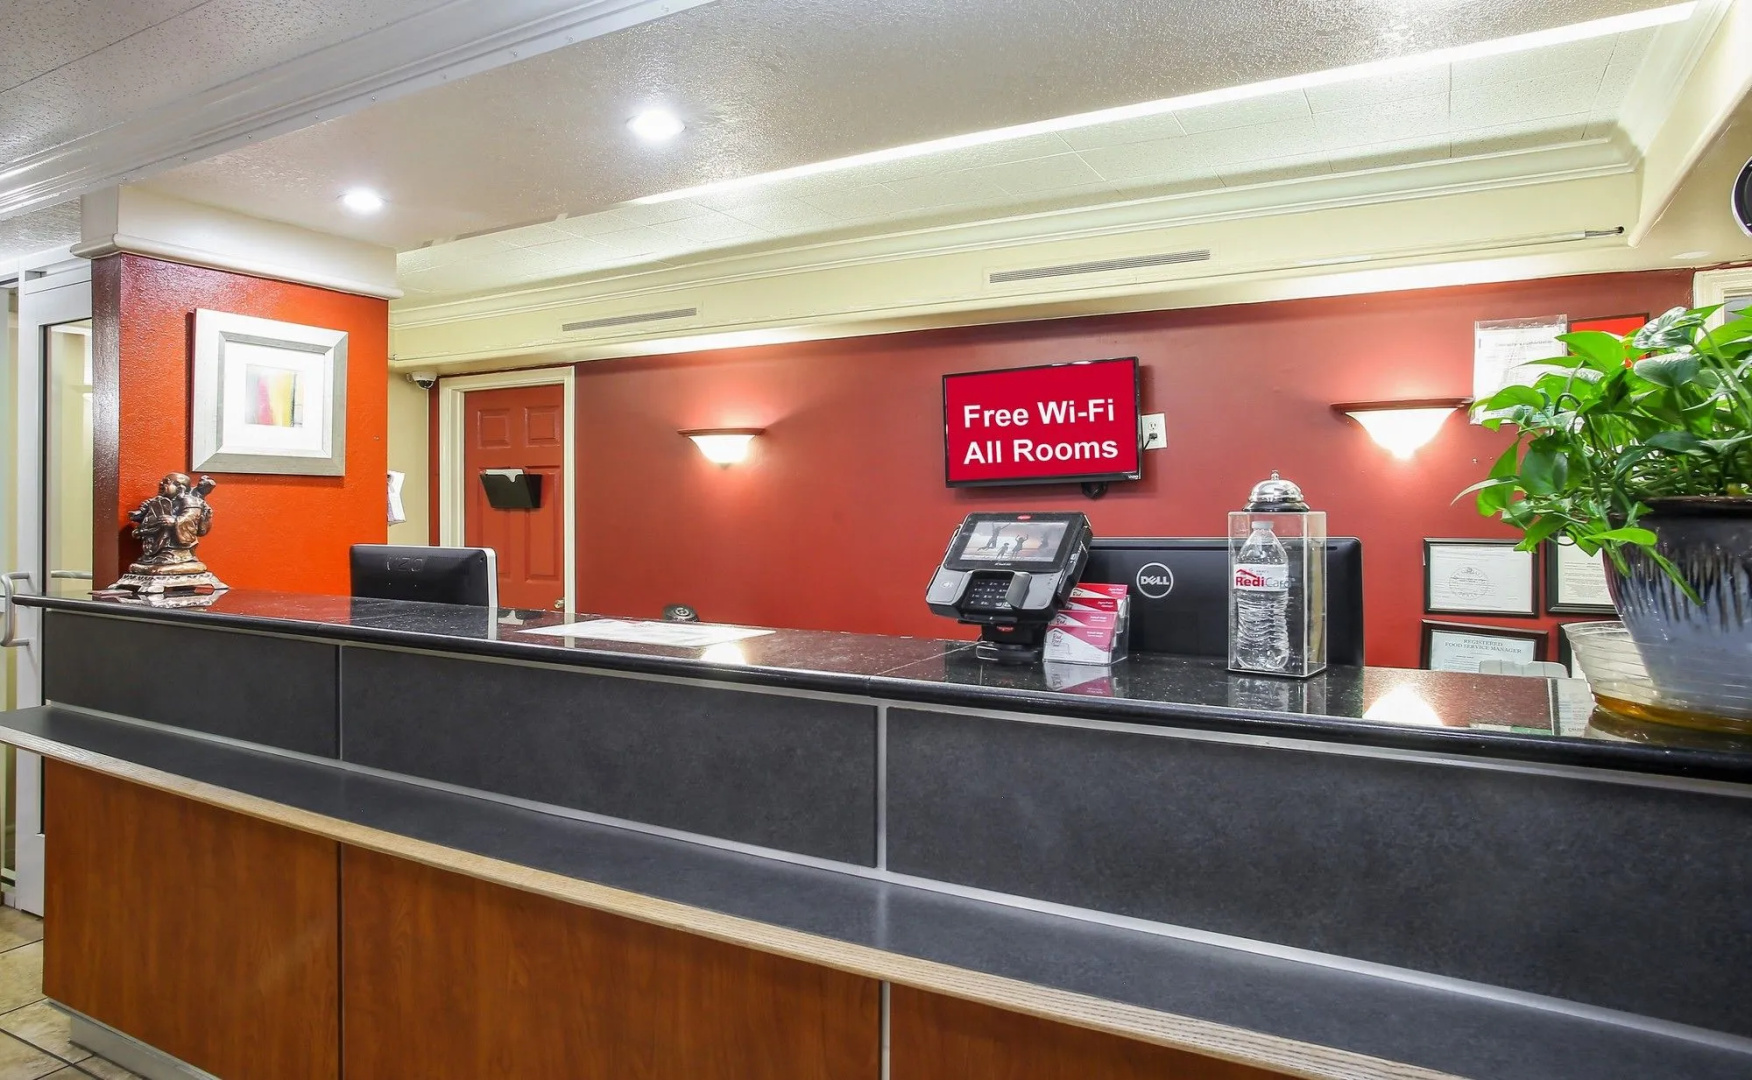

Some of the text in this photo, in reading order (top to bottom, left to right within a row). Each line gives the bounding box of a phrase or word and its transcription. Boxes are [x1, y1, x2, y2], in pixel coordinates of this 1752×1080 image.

[963, 398, 1115, 428] Free Wi-Fi
[963, 439, 1118, 464] All Rooms
[1140, 575, 1170, 586] DELL
[1464, 639, 1503, 647] REGISTERED
[1490, 646, 1522, 654] MANAGER
